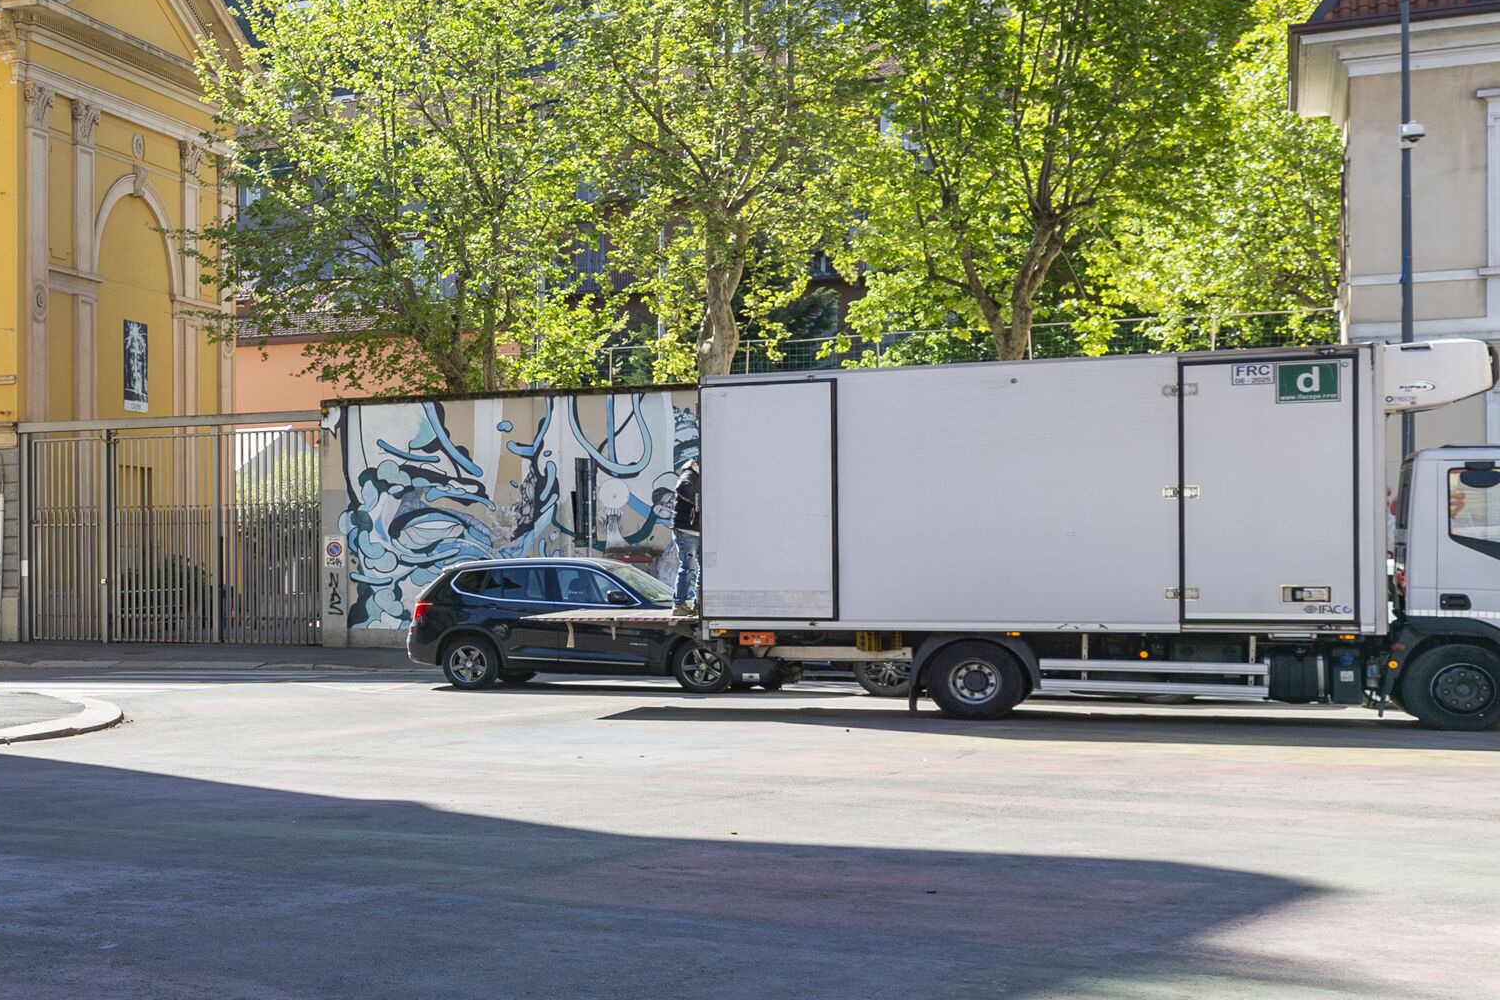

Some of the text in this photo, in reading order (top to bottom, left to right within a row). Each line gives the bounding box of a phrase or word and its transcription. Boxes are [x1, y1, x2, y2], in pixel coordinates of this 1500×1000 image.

[1236, 365, 1270, 377] FRC
[1296, 366, 1320, 392] d
[1318, 605, 1342, 615] IFAC
